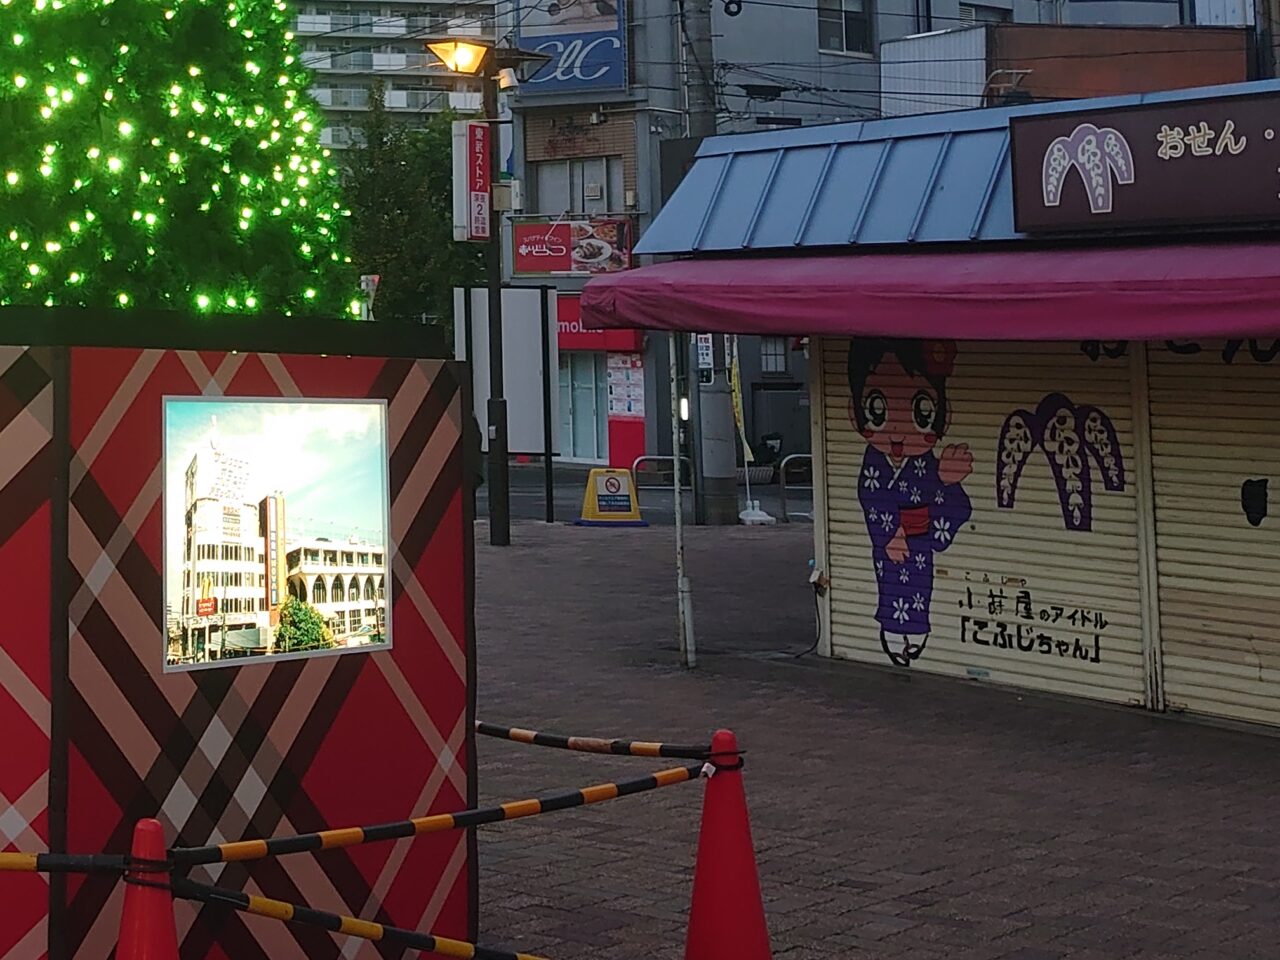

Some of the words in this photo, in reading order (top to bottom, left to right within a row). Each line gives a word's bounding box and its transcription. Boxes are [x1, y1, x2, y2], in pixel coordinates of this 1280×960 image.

[476, 204, 484, 216] 2
[961, 615, 1102, 664] 「こふじちゃん」
